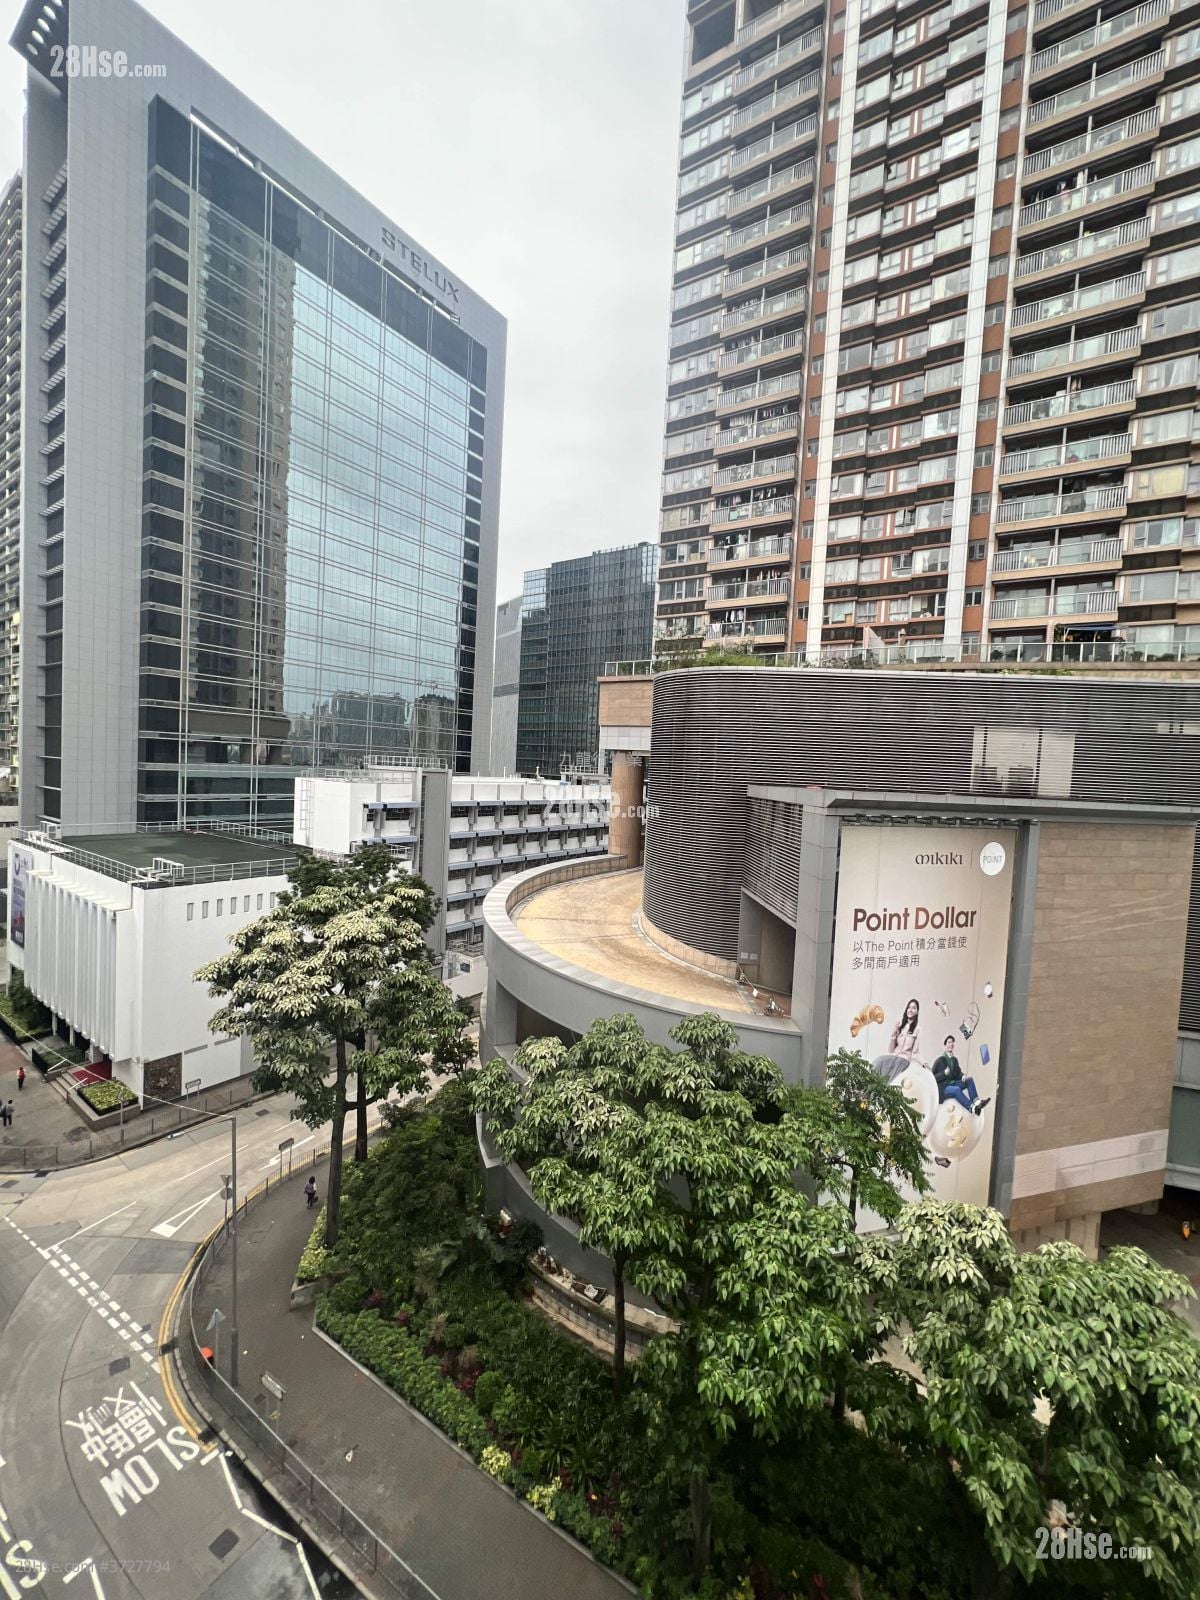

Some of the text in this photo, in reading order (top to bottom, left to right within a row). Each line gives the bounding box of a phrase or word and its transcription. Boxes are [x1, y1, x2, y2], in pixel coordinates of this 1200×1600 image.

[382, 227, 459, 303] STELUX
[915, 852, 963, 865] mikiki
[983, 855, 1003, 864] POINT
[853, 906, 977, 931] Point Dollar
[65, 1381, 167, 1468] 慢駛
[100, 1426, 200, 1516] SLOW
